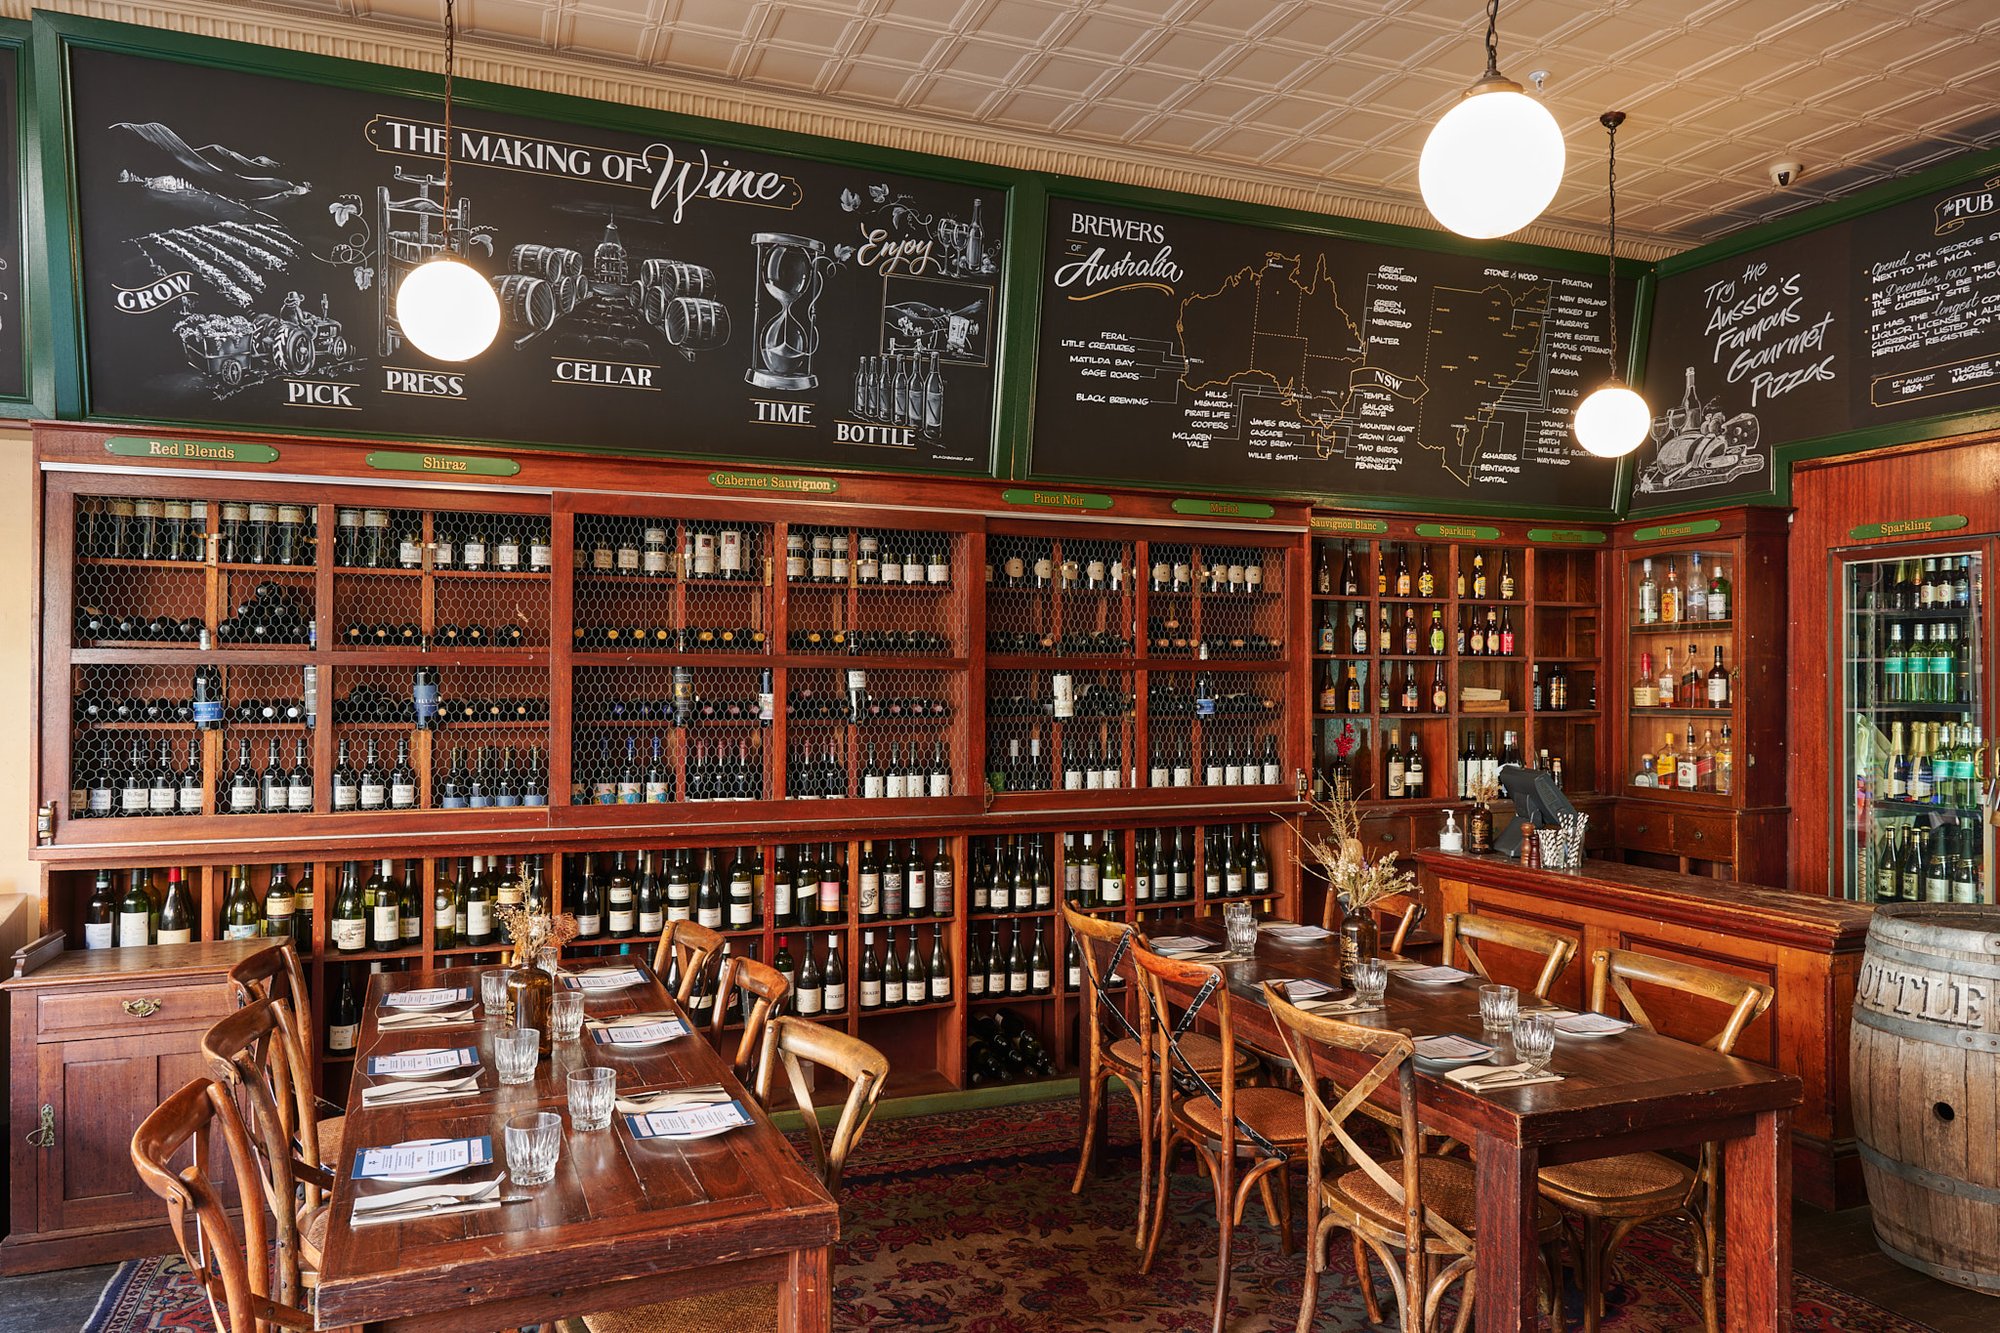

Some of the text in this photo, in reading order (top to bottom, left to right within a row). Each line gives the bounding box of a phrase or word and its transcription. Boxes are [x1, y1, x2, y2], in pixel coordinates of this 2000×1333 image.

[386, 122, 786, 225] THE MAKING OF Wine
[1955, 193, 1994, 216] PUB
[1071, 213, 1165, 244] BREWERS
[857, 222, 942, 277] Enjoy
[1070, 243, 1082, 252] OF
[1871, 250, 1910, 277] Opened
[1915, 251, 1931, 262] ON
[1936, 236, 1984, 256] GEORGE
[1054, 245, 1184, 287] Australia
[1378, 265, 1405, 274] GREAT
[1872, 249, 1976, 284] NEXT TO THE MCA.
[1377, 272, 1418, 283] NORTHERN
[1483, 268, 1510, 278] STONE
[1518, 272, 1539, 282] WOOD
[1872, 260, 1996, 301] IN December 1900 THE
[1376, 283, 1398, 291] XXXX
[1561, 278, 1593, 289] FIXATION
[1704, 262, 1768, 309] Try the
[117, 274, 190, 310] GROW
[1872, 298, 1892, 309] THE
[1897, 288, 1932, 301] HOTEL
[1935, 283, 1950, 292] TO
[1955, 277, 1972, 287] BE
[1373, 299, 1402, 308] GREEN
[1559, 295, 1607, 307] NEW ENGLAND
[1894, 293, 1941, 311] CURRENT
[1945, 285, 1970, 297] SITE
[1704, 273, 1801, 336] Aussie's
[1373, 306, 1406, 315] BEACON
[1557, 307, 1598, 318] WICKED ELF
[1872, 323, 1881, 332] IT
[1883, 318, 1905, 329] HAS
[1909, 312, 1928, 322] THE
[1932, 290, 1980, 318] longest
[1371, 318, 1412, 329] NEWSTEAD
[1871, 315, 1914, 341] LIQUOR
[1917, 314, 1961, 330] LICENSE
[1965, 310, 1977, 319] IN
[1713, 296, 1803, 364] Famous
[1871, 330, 1930, 349] CURRENTLY
[1933, 321, 1968, 335] LISTED
[1973, 316, 1991, 326] ON
[1101, 331, 1128, 341] FERAL
[1369, 335, 1400, 345] BALTER
[1554, 332, 1600, 342] HOPE ESTATE
[1061, 339, 1136, 353] LITTLE CREATURES
[1552, 342, 1577, 351] MODUS
[1726, 311, 1835, 383] Gourmet
[1871, 327, 1985, 357] HERITAGE REGISTER.
[1069, 355, 1135, 367] MATILDA BAY
[1560, 352, 1582, 362] PINES
[556, 361, 653, 388] CELLAR
[1081, 368, 1140, 380] GAGE ROADS
[1550, 367, 1579, 377] AKASHA
[386, 370, 464, 396] PRESS
[1374, 370, 1403, 391] NSW
[1750, 354, 1836, 408] Pizzas
[1905, 373, 1936, 385] AUGUST
[1902, 383, 1924, 394] 1824
[288, 382, 353, 407] PICK
[1076, 393, 1149, 406] BLACK BREWING
[1205, 390, 1228, 399] HILLS
[1363, 392, 1391, 401] TEMPLE
[1194, 400, 1233, 409] MISMATCH
[754, 402, 811, 425] TIME
[1184, 409, 1231, 419] PIRATE LIFE
[1361, 409, 1387, 418] GRAVE
[1552, 407, 1569, 415] LORD
[1191, 421, 1229, 430] COOPERS
[1250, 418, 1301, 429] JAMES BOAGS
[1360, 422, 1415, 433] MOUNTAIN GOAT
[1540, 420, 1564, 429] YOUNG
[837, 423, 916, 447] BOTTLE
[1172, 432, 1212, 441] MCLAREN
[1250, 429, 1283, 438] CASCADE
[1358, 432, 1384, 441] CROWN
[1539, 429, 1568, 438] GRIFTER
[1186, 440, 1209, 449] VALE
[1249, 439, 1293, 448] MOO BREW
[1538, 437, 1560, 446] BATCH
[149, 441, 235, 460] Red Blends
[1357, 443, 1398, 454] TWO BIRDS
[1538, 446, 1560, 455] WILLIE
[1248, 451, 1298, 462] WILLIE SMITH
[1355, 455, 1402, 465] MORNINGTON
[1482, 452, 1518, 461] SCHARERS
[1536, 457, 1570, 465] WAYWARD
[423, 455, 467, 472] Shiraz
[1355, 462, 1397, 471] PENINSULA
[1480, 464, 1520, 473] BENTSPOKE
[716, 473, 831, 491] Cabernet Sauvignon
[1479, 476, 1508, 484] CAPITAL
[1033, 493, 1085, 506] Pinot Noir
[1210, 503, 1239, 514] Merlot
[1310, 517, 1377, 530] Sauvignon Blanc
[1880, 519, 1932, 535] Sparkling
[1439, 525, 1477, 538] Sparkling
[1659, 525, 1691, 537] Museum
